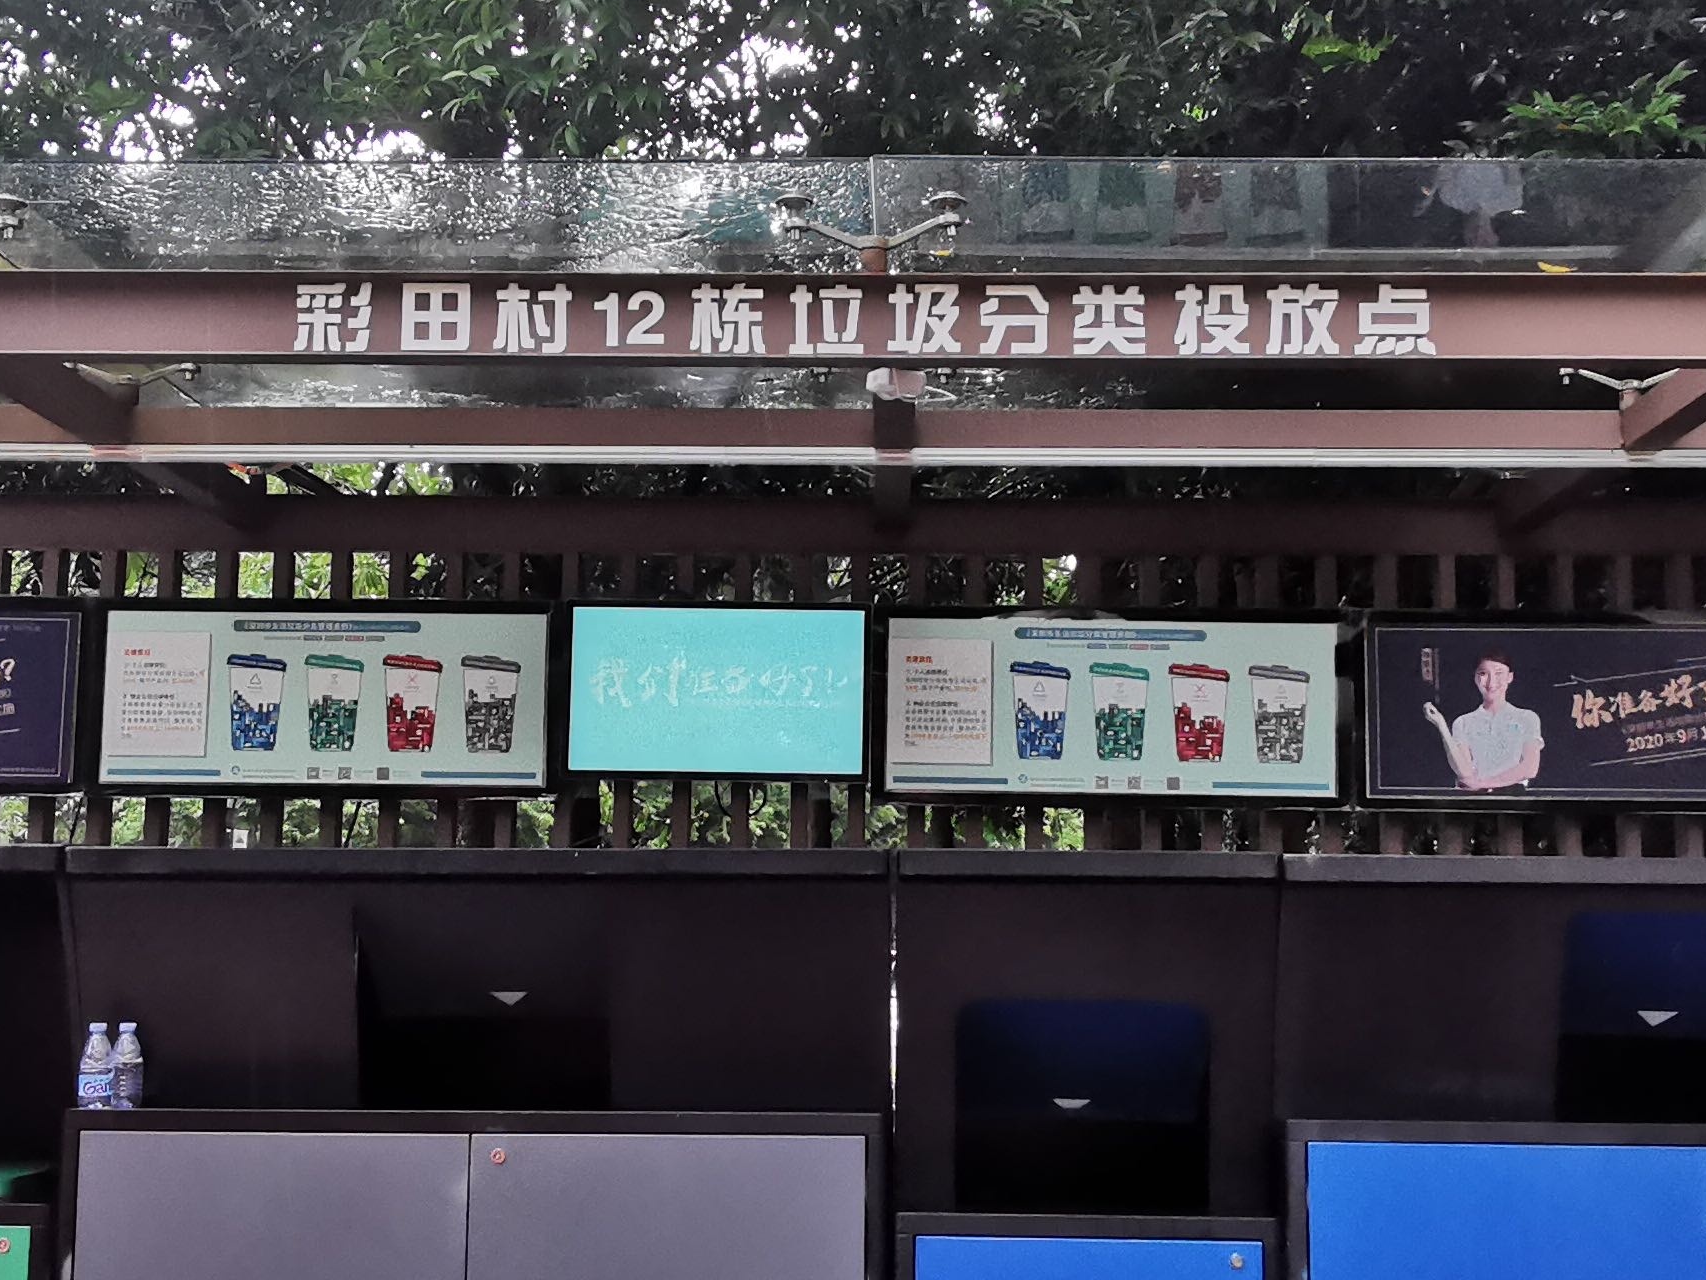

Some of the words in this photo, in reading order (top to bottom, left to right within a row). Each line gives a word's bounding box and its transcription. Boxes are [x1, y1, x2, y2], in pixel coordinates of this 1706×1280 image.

[293, 281, 1439, 358] 彩田村12栋垃圾分类投放点
